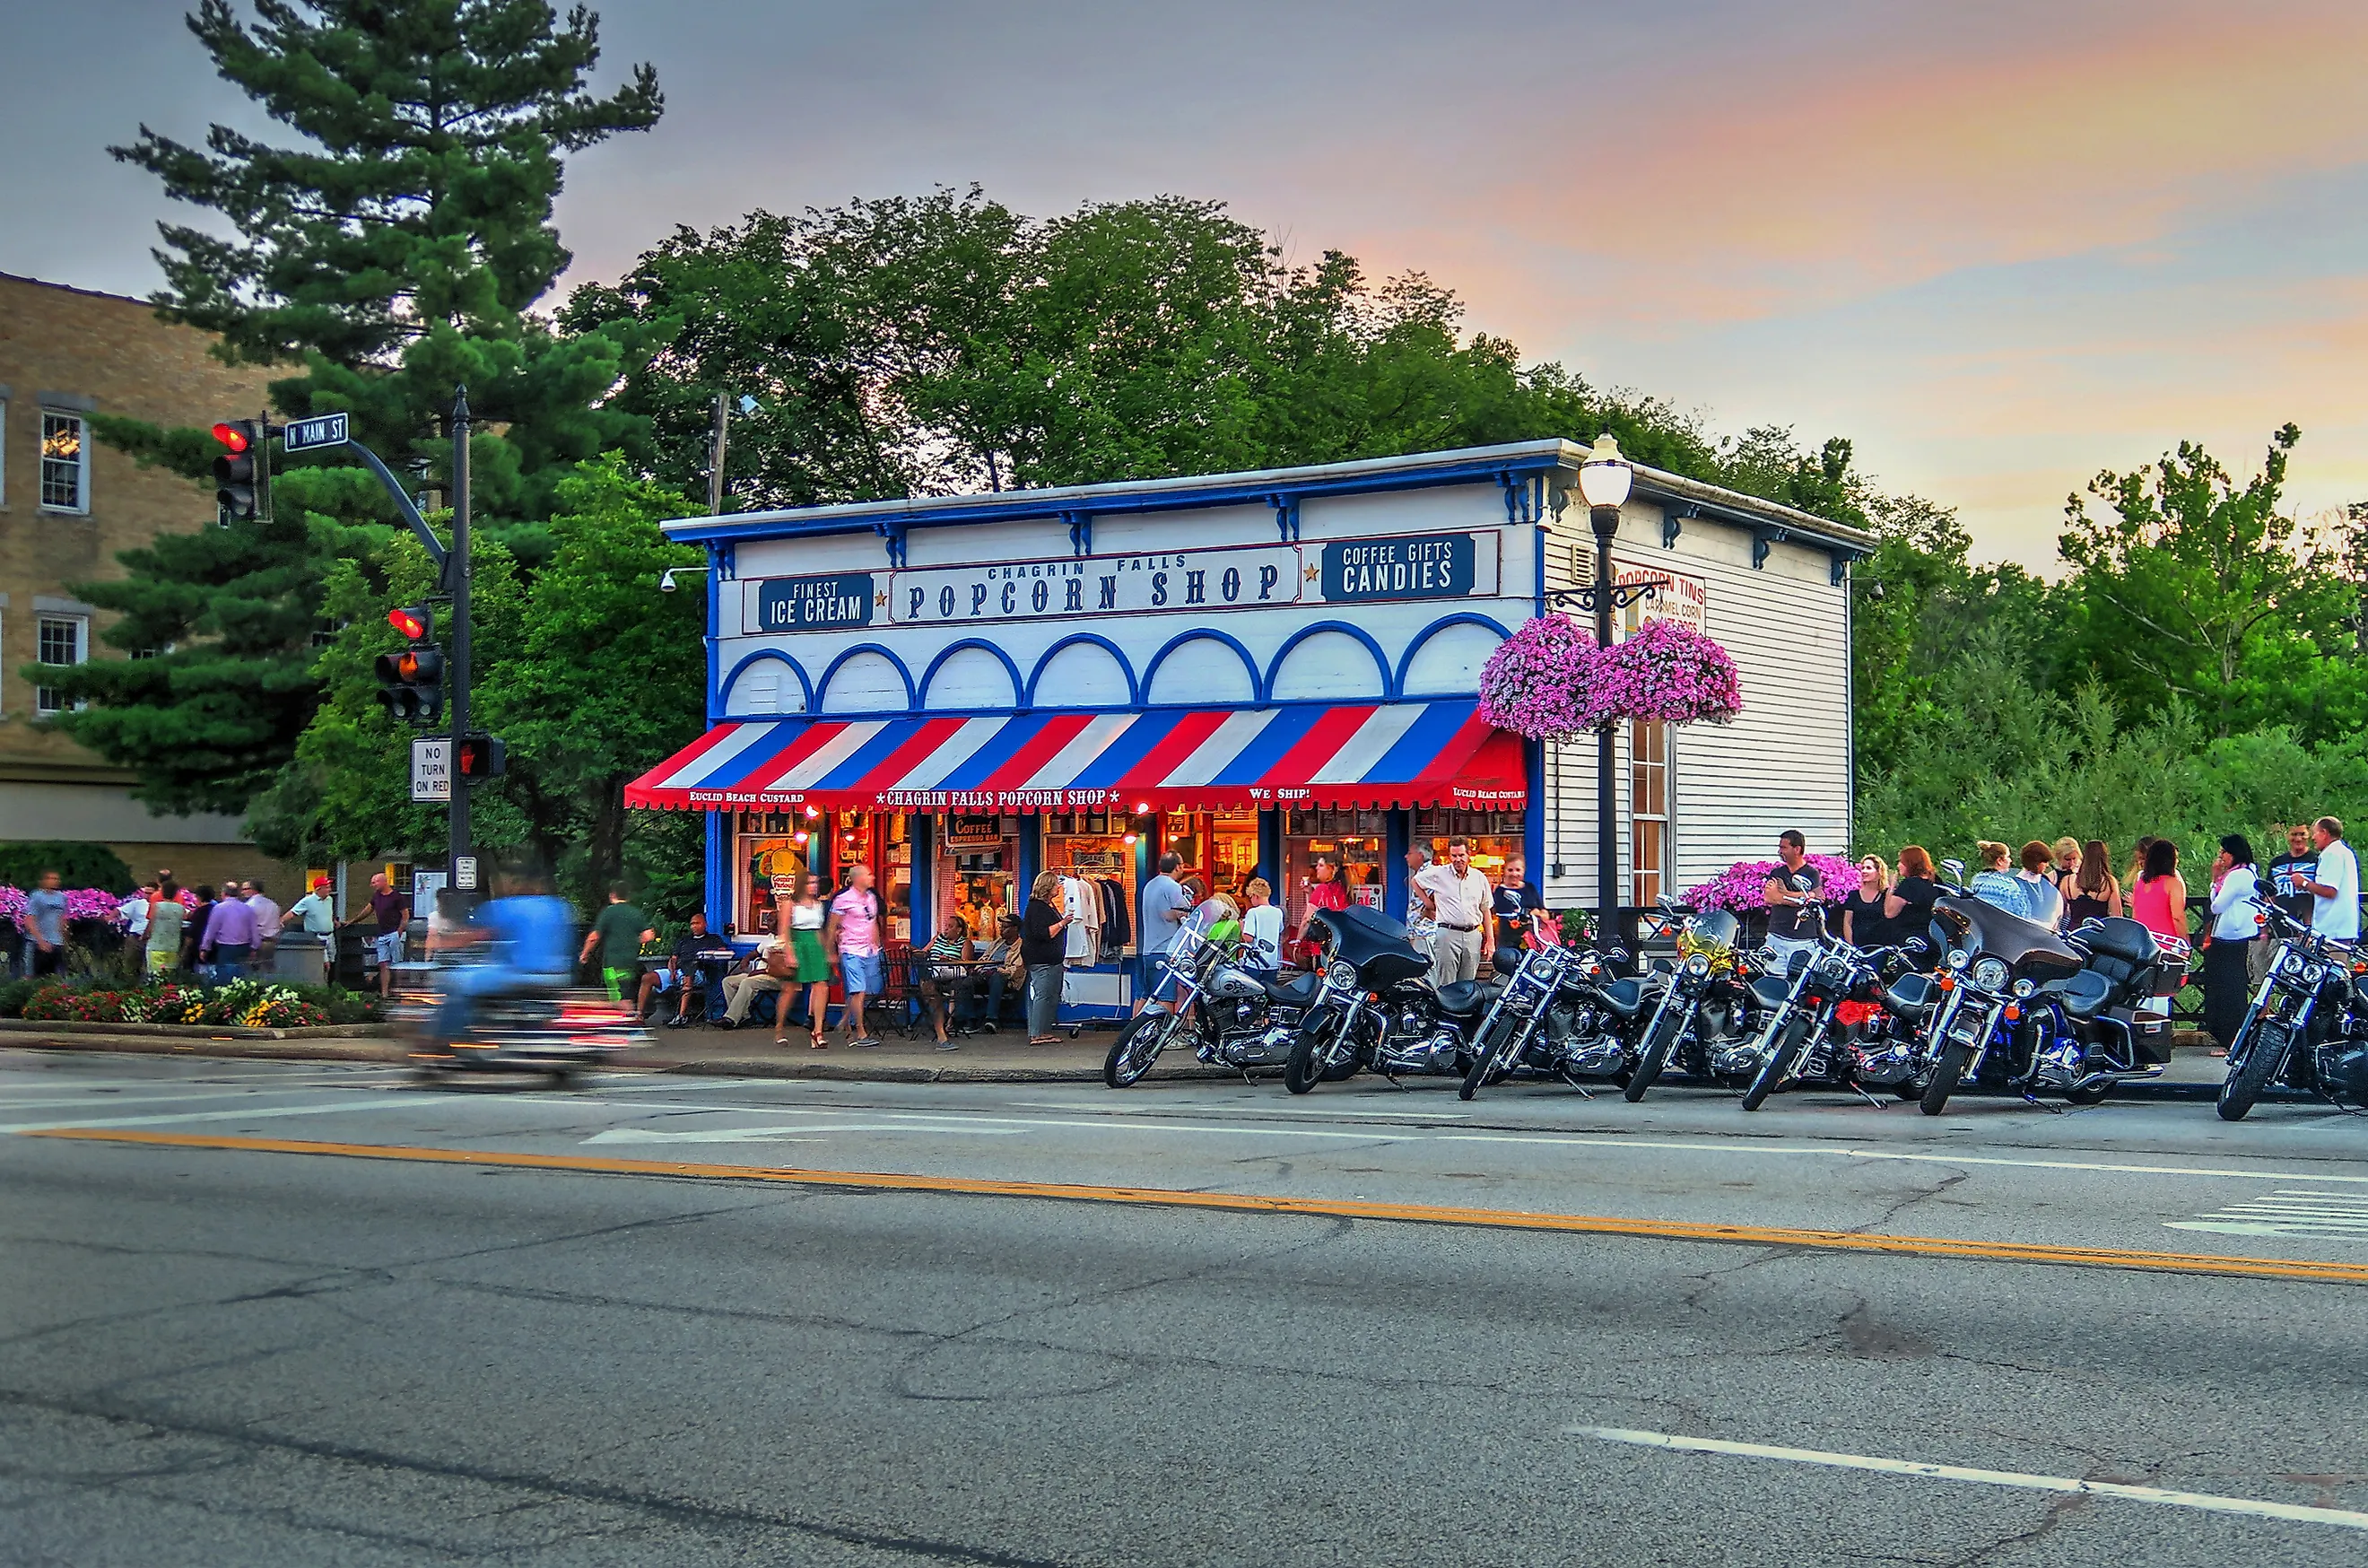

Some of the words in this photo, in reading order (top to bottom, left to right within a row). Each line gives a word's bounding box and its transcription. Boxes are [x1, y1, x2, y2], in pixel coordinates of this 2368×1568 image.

[290, 427, 297, 446] N
[302, 422, 326, 443] MAIN
[332, 418, 344, 439] ST
[1343, 545, 1397, 565] COFFEE
[1407, 541, 1453, 562] GIFTS
[988, 562, 1084, 580] CHAGRIN
[1117, 554, 1186, 571] FALLS
[1343, 561, 1452, 593] CANDIES
[793, 581, 839, 599] FINEST
[908, 575, 1117, 619] POPCORN
[1151, 564, 1278, 606] SHOP
[1679, 578, 1704, 605] TINS
[771, 599, 797, 624] ICE
[805, 596, 861, 623] CREAM
[1682, 604, 1702, 620] CORN
[425, 747, 441, 759] NO
[421, 764, 445, 776] TURN
[416, 780, 428, 792] ON
[432, 780, 449, 792] RED
[1249, 788, 1271, 799] WE
[1277, 788, 1310, 799] SHIP!
[689, 791, 723, 801] EUCLID
[726, 792, 757, 802] BEACH
[760, 793, 805, 803] CUSTARD
[886, 790, 947, 806] CHAGRIN
[951, 791, 994, 806] FALLS
[997, 790, 1063, 806] POPCORN
[1067, 790, 1106, 806] SHOP
